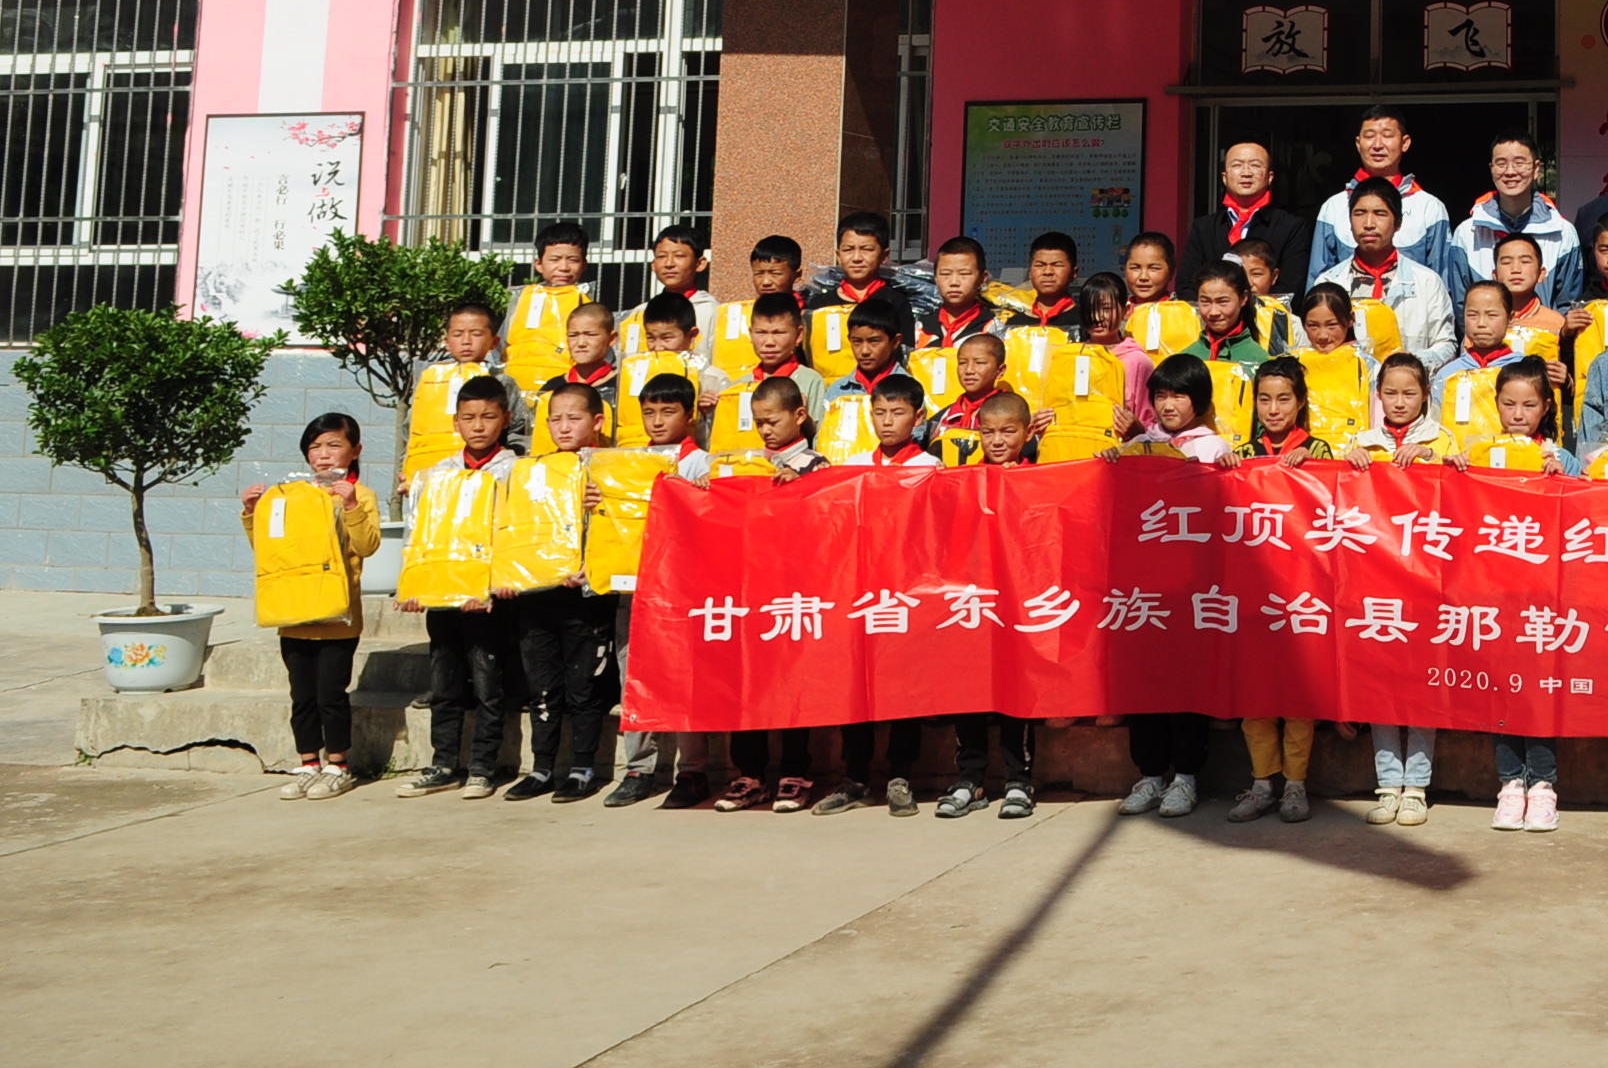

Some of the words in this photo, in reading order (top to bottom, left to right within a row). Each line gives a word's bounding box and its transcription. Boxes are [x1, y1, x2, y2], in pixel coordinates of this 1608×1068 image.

[1261, 19, 1309, 59] 放
[1448, 19, 1488, 59] 飞
[987, 113, 1122, 132] 交通安全教育宣传栏
[1426, 666, 1523, 694] 2020.9
[1538, 677, 1593, 695] 中国
